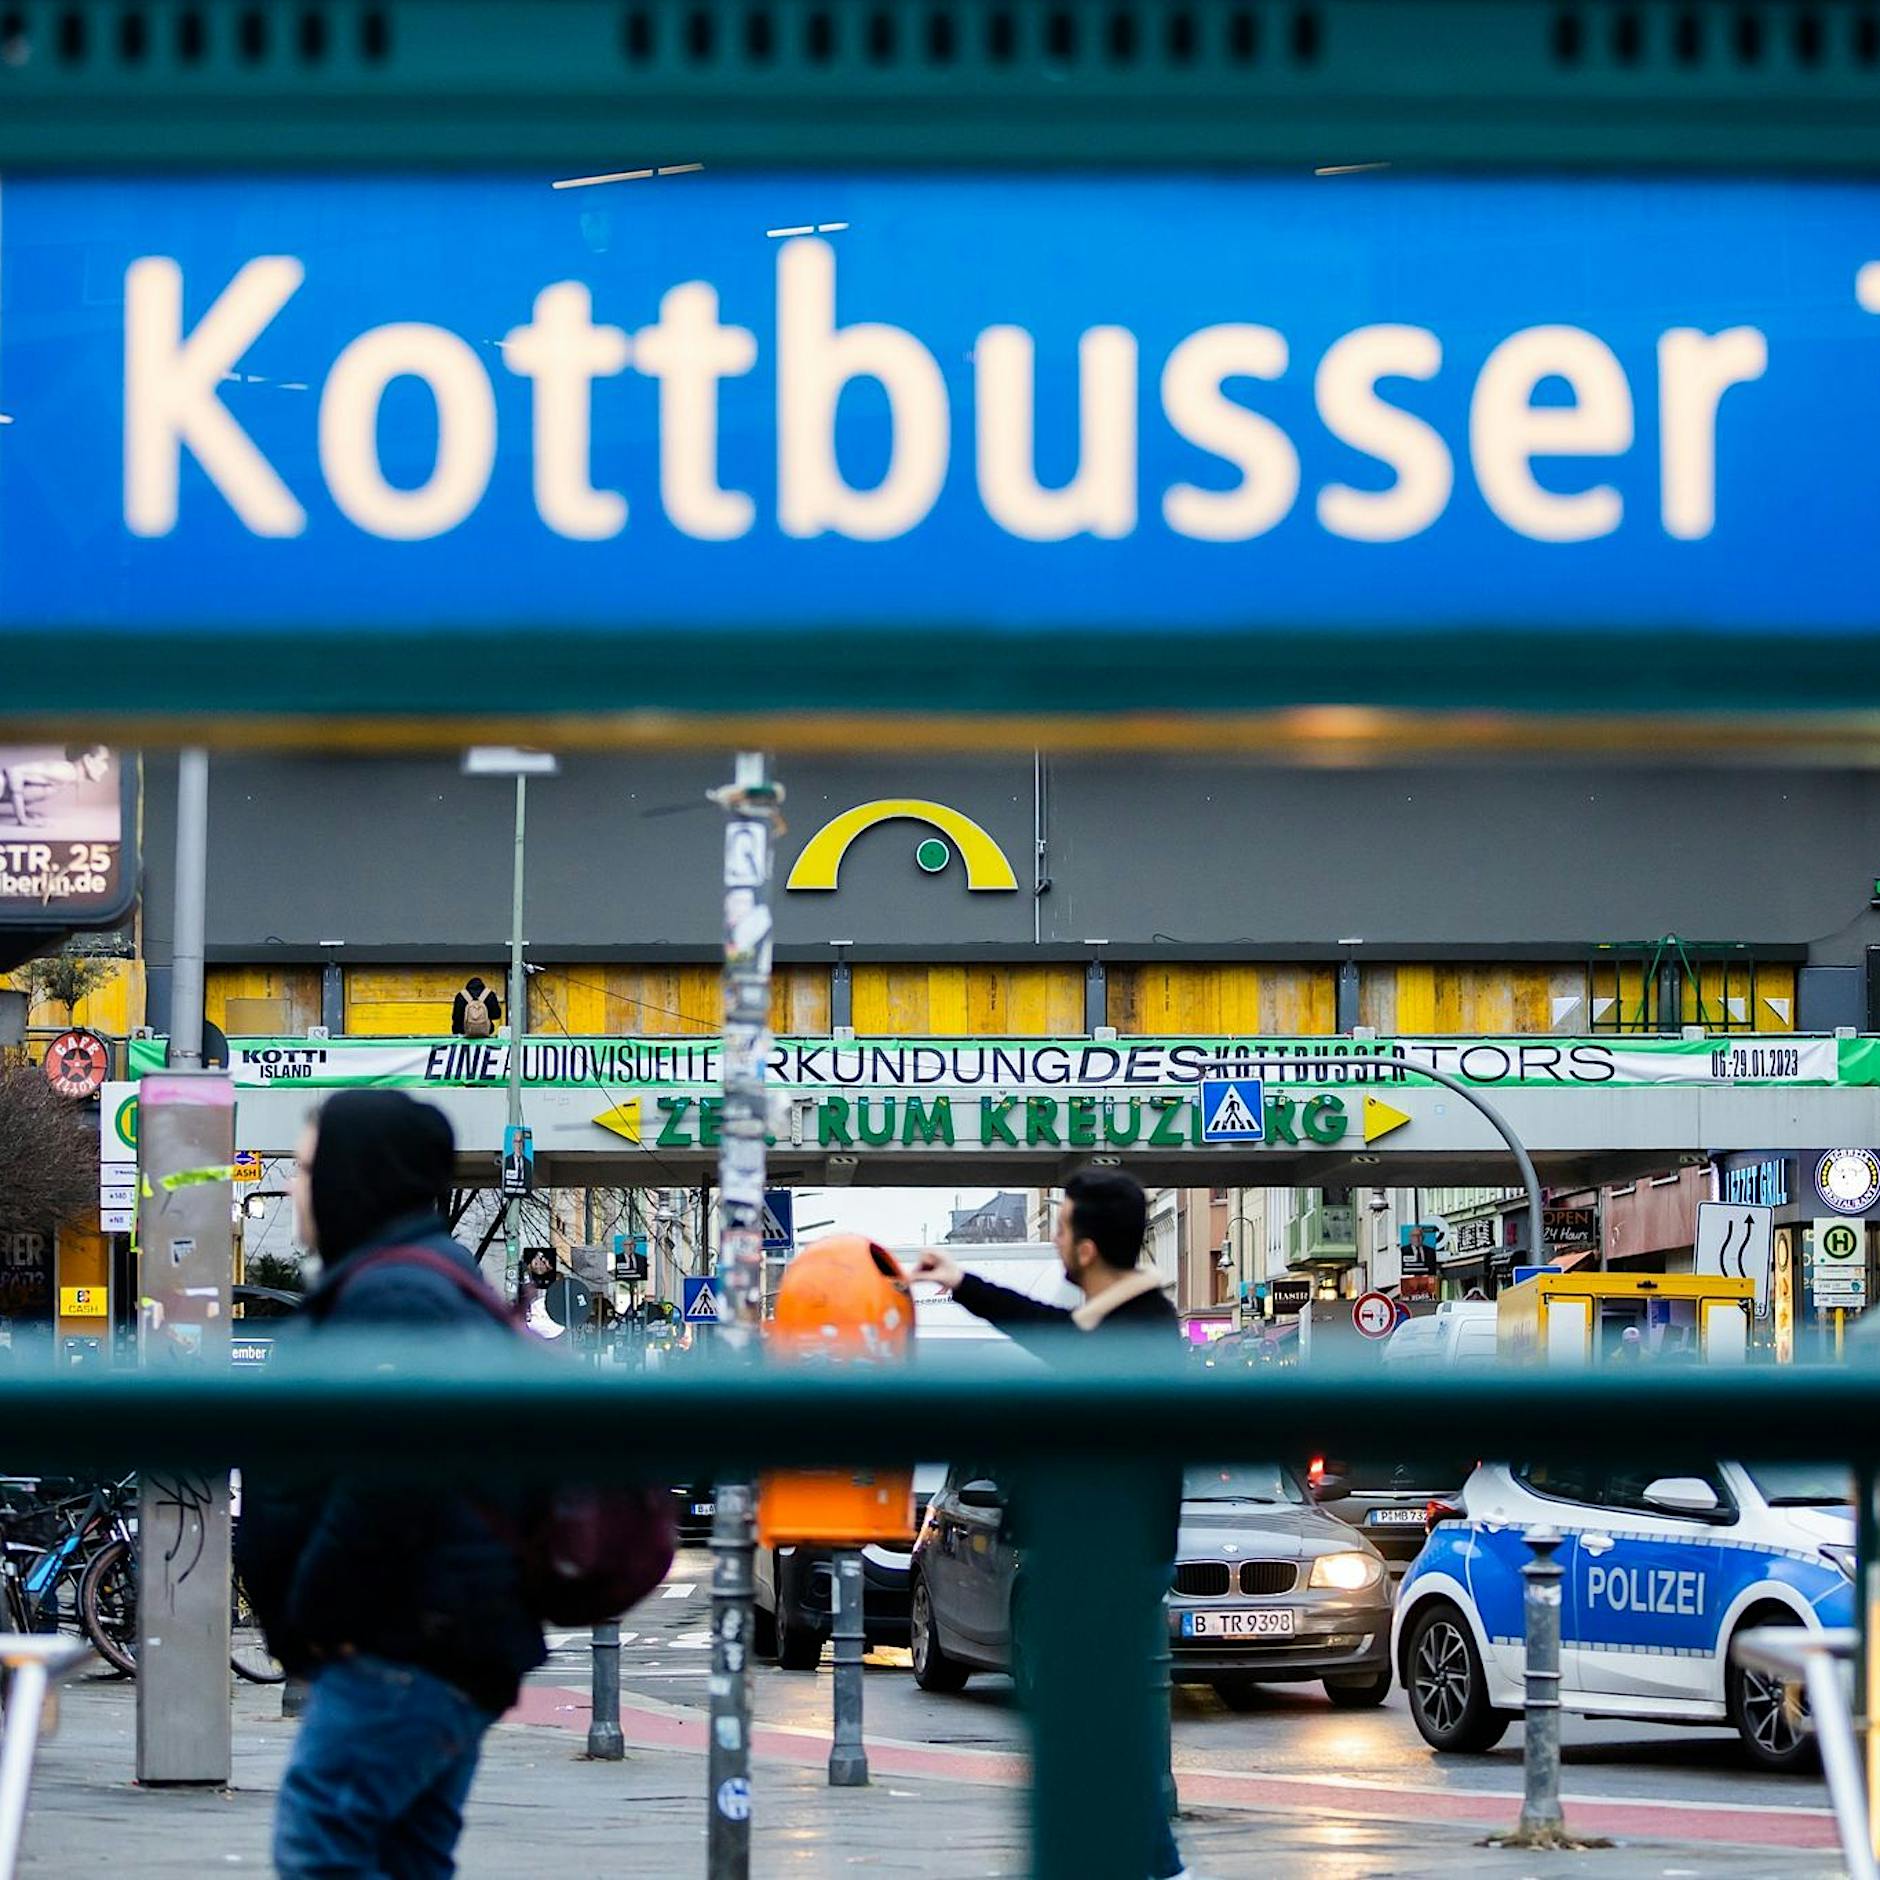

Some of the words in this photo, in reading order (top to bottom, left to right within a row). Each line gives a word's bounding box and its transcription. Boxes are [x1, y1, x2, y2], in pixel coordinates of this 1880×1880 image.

[123, 237, 1768, 543] Kottbusser
[68, 843, 111, 872] 25
[242, 1050, 326, 1063] KOTTI
[424, 1044, 501, 1080] EINE
[763, 1046, 1069, 1083] RKUNDUNG
[1078, 1046, 1207, 1083] DES
[1411, 1045, 1615, 1082] TORS
[260, 1065, 311, 1078] ISLAND
[656, 1096, 955, 1147] ZETRUM
[981, 1094, 1348, 1147] KREUZRG
[237, 1169, 257, 1177] ASH
[1588, 1566, 1705, 1615] POLIZEI
[1195, 1616, 1206, 1632] B
[1219, 1615, 1242, 1633] TR
[1247, 1614, 1290, 1632] 9398
